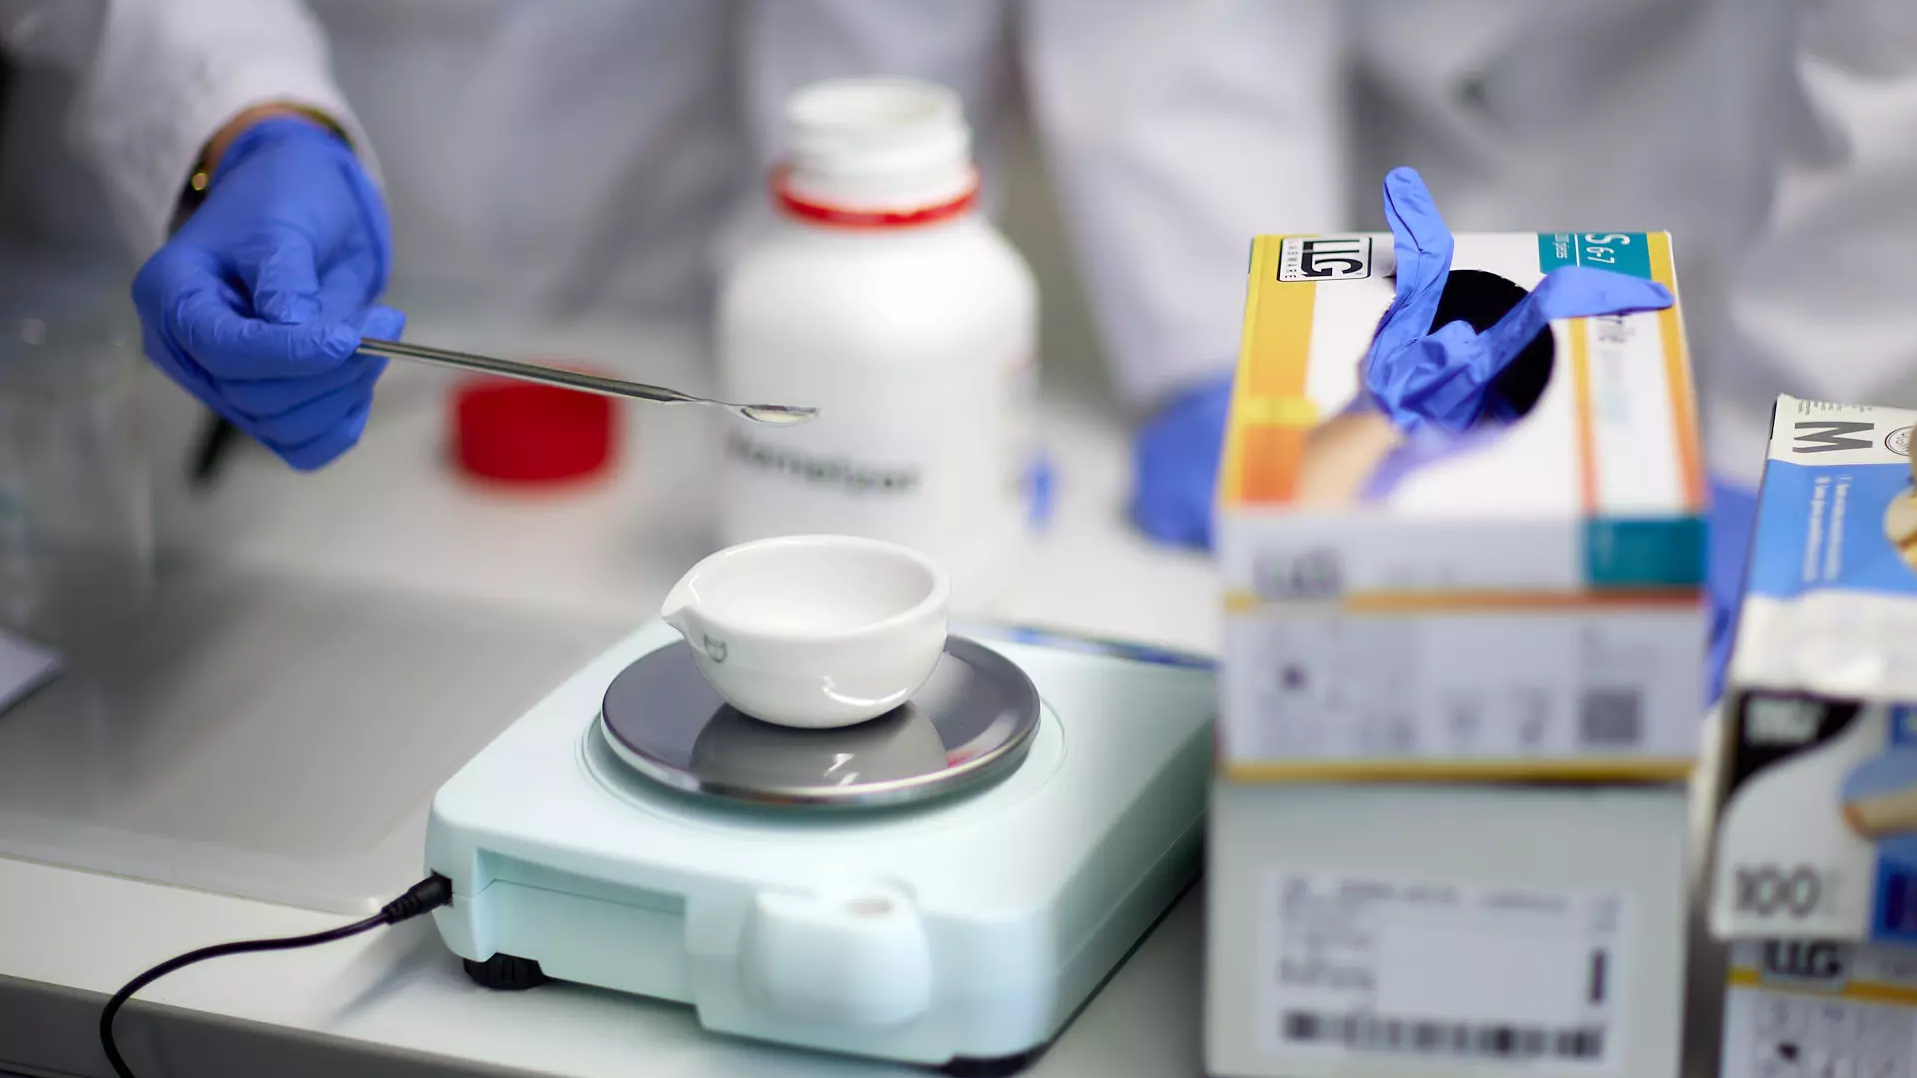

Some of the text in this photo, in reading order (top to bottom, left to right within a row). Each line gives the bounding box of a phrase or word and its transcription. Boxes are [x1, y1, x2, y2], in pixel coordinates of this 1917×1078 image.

[1301, 238, 1364, 277] LLG
[1585, 233, 1631, 264] S 6-7
[1792, 421, 1875, 454] M
[1736, 864, 1822, 917] 100
